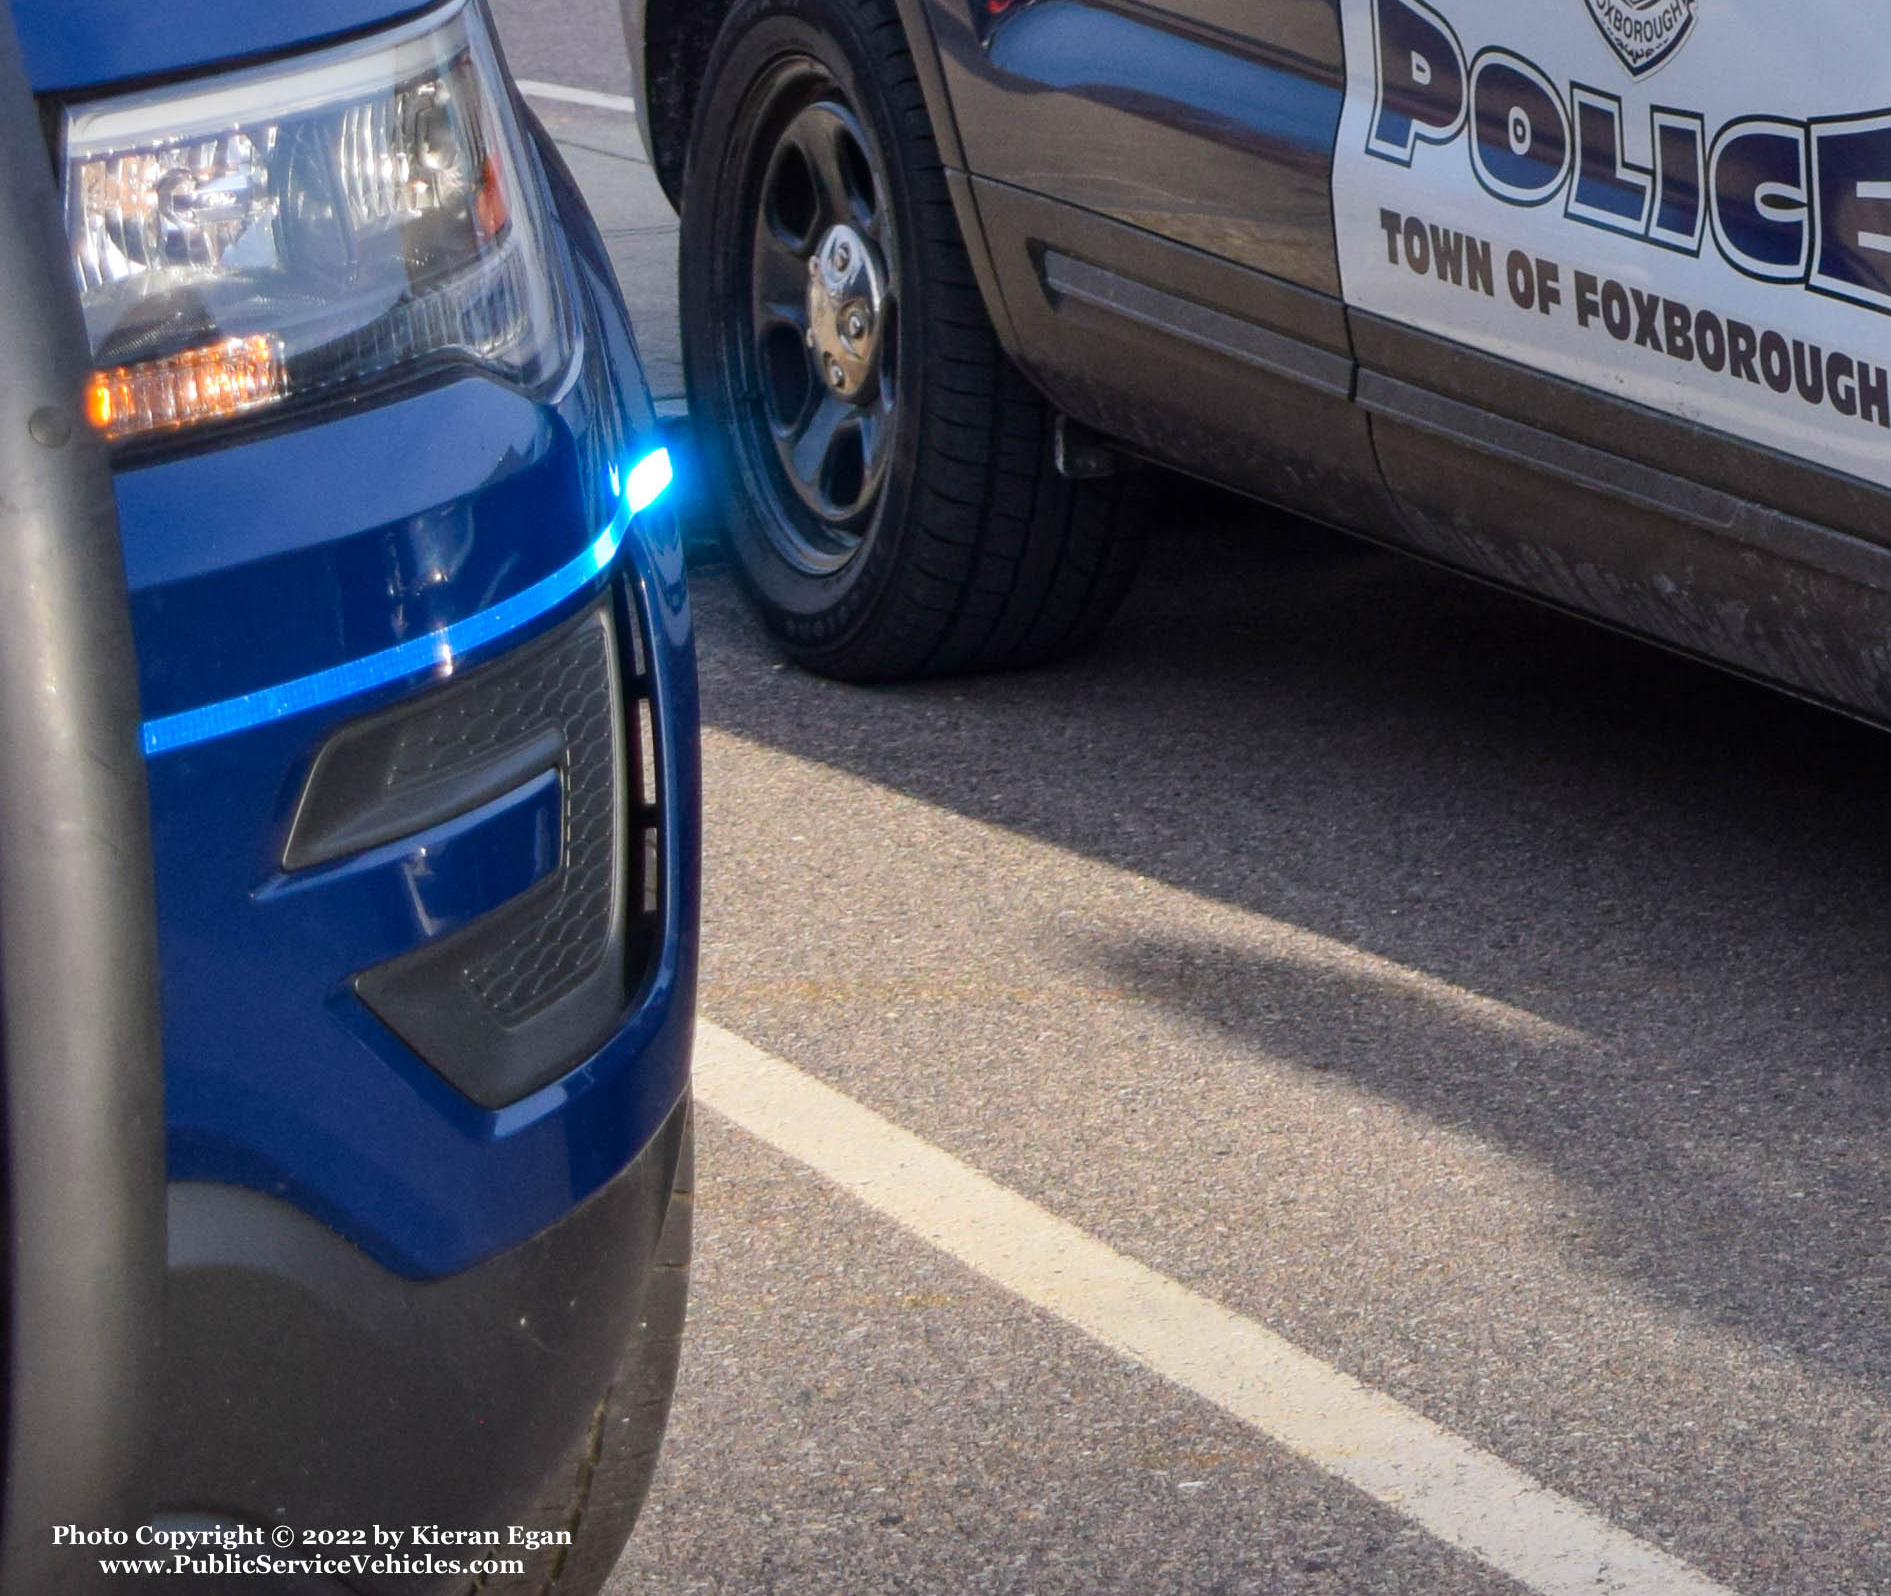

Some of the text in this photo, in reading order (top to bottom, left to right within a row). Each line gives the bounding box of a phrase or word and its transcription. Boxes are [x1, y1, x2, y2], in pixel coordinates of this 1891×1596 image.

[1379, 208, 1891, 429] TOWN OF FOXBOROUGH
